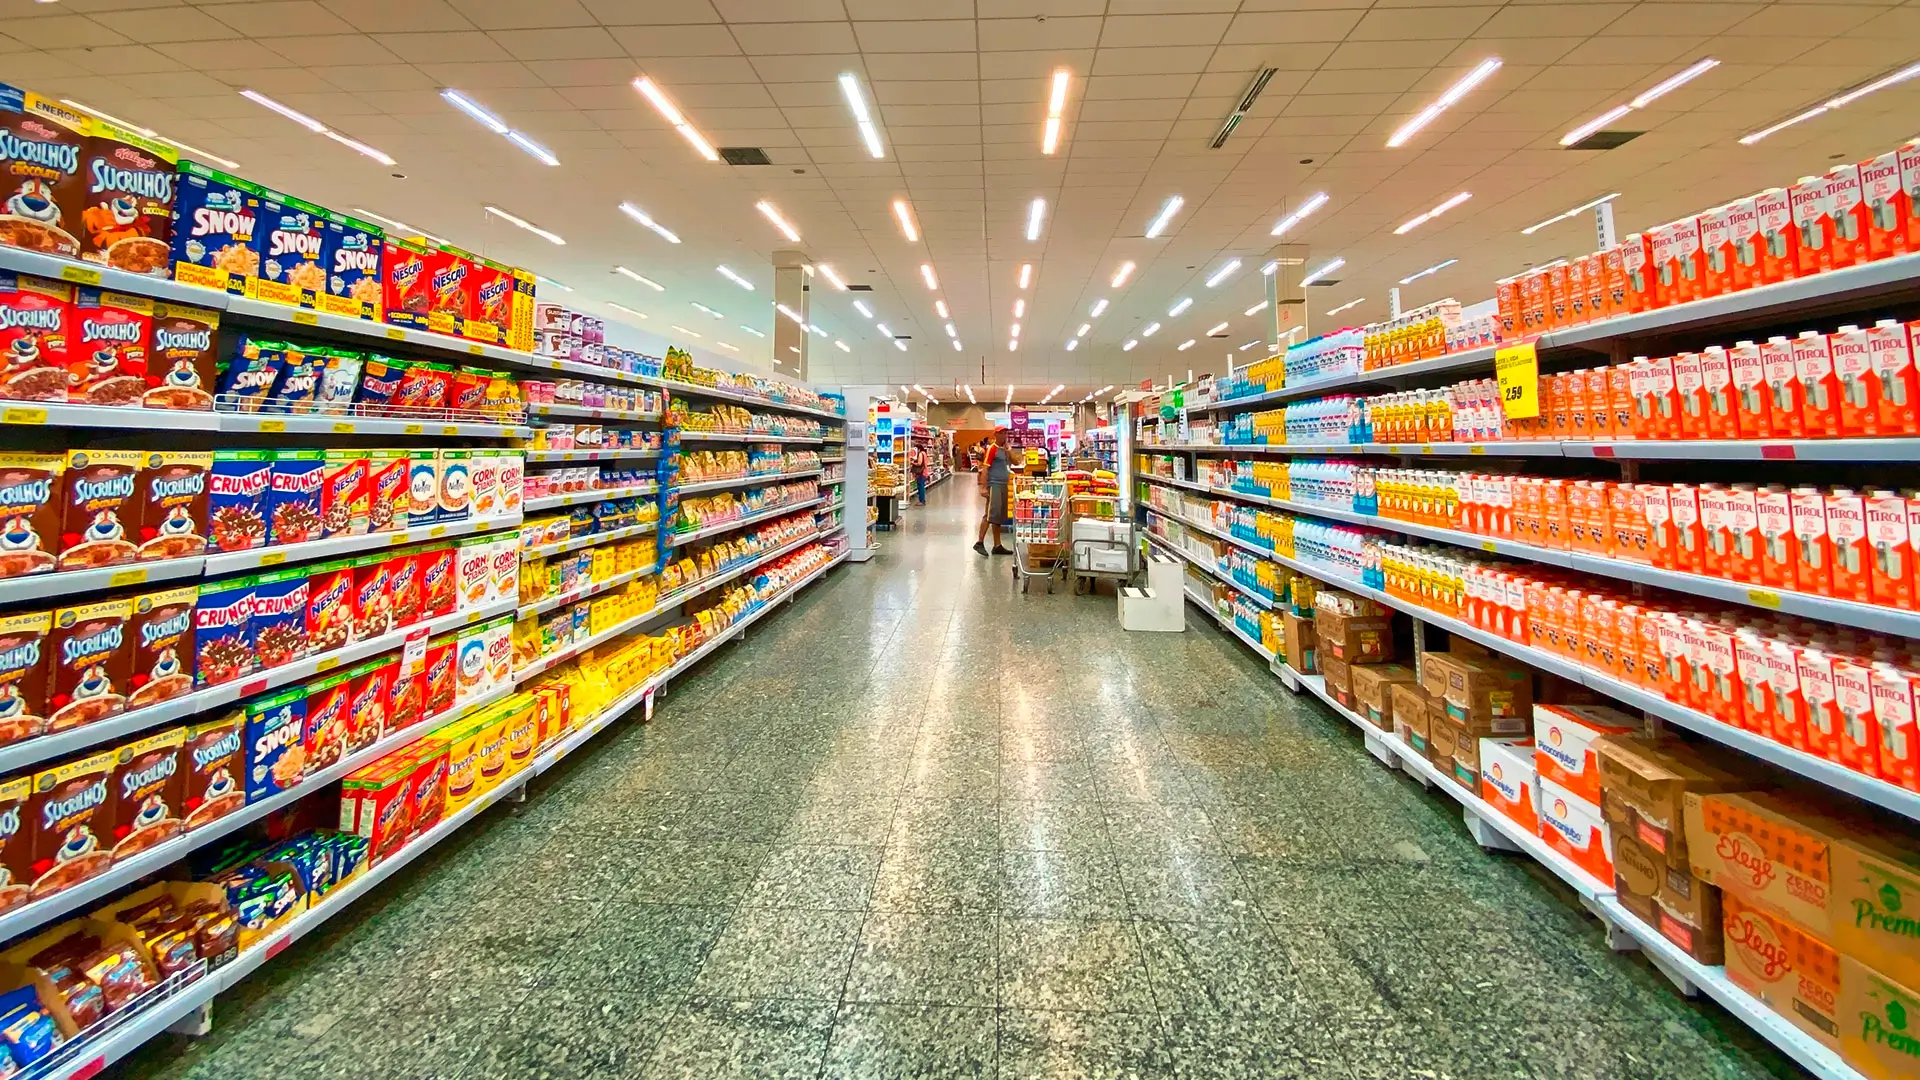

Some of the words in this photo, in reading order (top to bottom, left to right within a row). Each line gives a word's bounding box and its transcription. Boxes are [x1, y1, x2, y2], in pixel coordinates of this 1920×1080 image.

[91, 159, 174, 204] SUCRILHOS
[1825, 178, 1858, 195] TIROL
[1863, 167, 1898, 183] TIROL
[1758, 202, 1787, 216] TIROL
[1793, 189, 1824, 205] TIROL
[192, 207, 256, 236] SNOW
[269, 230, 322, 256] SNOW
[334, 249, 378, 272] SNOW
[392, 261, 423, 284] NESCAU
[432, 265, 467, 292] NESCAU
[479, 279, 509, 303] NESCAU
[0, 305, 62, 331] SUCRILHOS
[83, 319, 141, 343] SUCRILHOS
[156, 329, 210, 351] SUCRILHOS
[1795, 349, 1828, 361] TIROL
[1833, 344, 1868, 356] TIROL
[1870, 339, 1905, 352] TIROL
[1732, 355, 1759, 366] TIROL
[1763, 353, 1793, 365] TIROL
[232, 371, 278, 390] SNOW
[152, 472, 204, 502] SUCRILHOS
[211, 469, 270, 493] CRUNCH
[272, 469, 324, 491] CRUNCH
[332, 466, 364, 495] NESCAU
[378, 466, 406, 491] NESCAU
[473, 467, 496, 485] CORN
[500, 467, 521, 483] CORN
[75, 474, 135, 505] SUCRILHOS
[1758, 503, 1787, 515] TIROL
[1793, 505, 1823, 518] TIROL
[1828, 508, 1861, 521] TIROL
[1868, 510, 1904, 524] TIROL
[424, 554, 452, 586] NESCAU
[463, 555, 487, 576] CORN
[493, 549, 516, 569] CORN
[256, 585, 309, 614] CRUNCH
[311, 577, 350, 618] NESCAU
[358, 570, 390, 608] NESCAU
[93, 601, 131, 612] SABOR
[197, 595, 255, 627] CRUNCH
[142, 609, 191, 648] SUCRILHOS
[63, 624, 123, 665] SUCRILHOS
[489, 634, 510, 657] CORN
[427, 648, 455, 686] NESCAU
[1766, 658, 1795, 674] TIROL
[1800, 666, 1831, 683] TIROL
[1835, 675, 1868, 694] TIROL
[1873, 685, 1909, 704] TIROL
[350, 674, 382, 724] NESCAU
[308, 689, 346, 740] NESCAU
[194, 730, 240, 772] SUCRILHOS
[254, 717, 304, 763] SNOW
[73, 754, 115, 770] SABOR
[1538, 740, 1577, 766] Piracanjuba
[122, 752, 178, 800] SUCRILHOS
[415, 758, 447, 805] NESCAU
[1483, 770, 1515, 796] Piracanjuba
[43, 778, 108, 830] SUCRILHOS
[379, 780, 413, 828] NESCAU
[1786, 872, 1825, 899] ZERO
[1799, 974, 1834, 1006] ZERO
